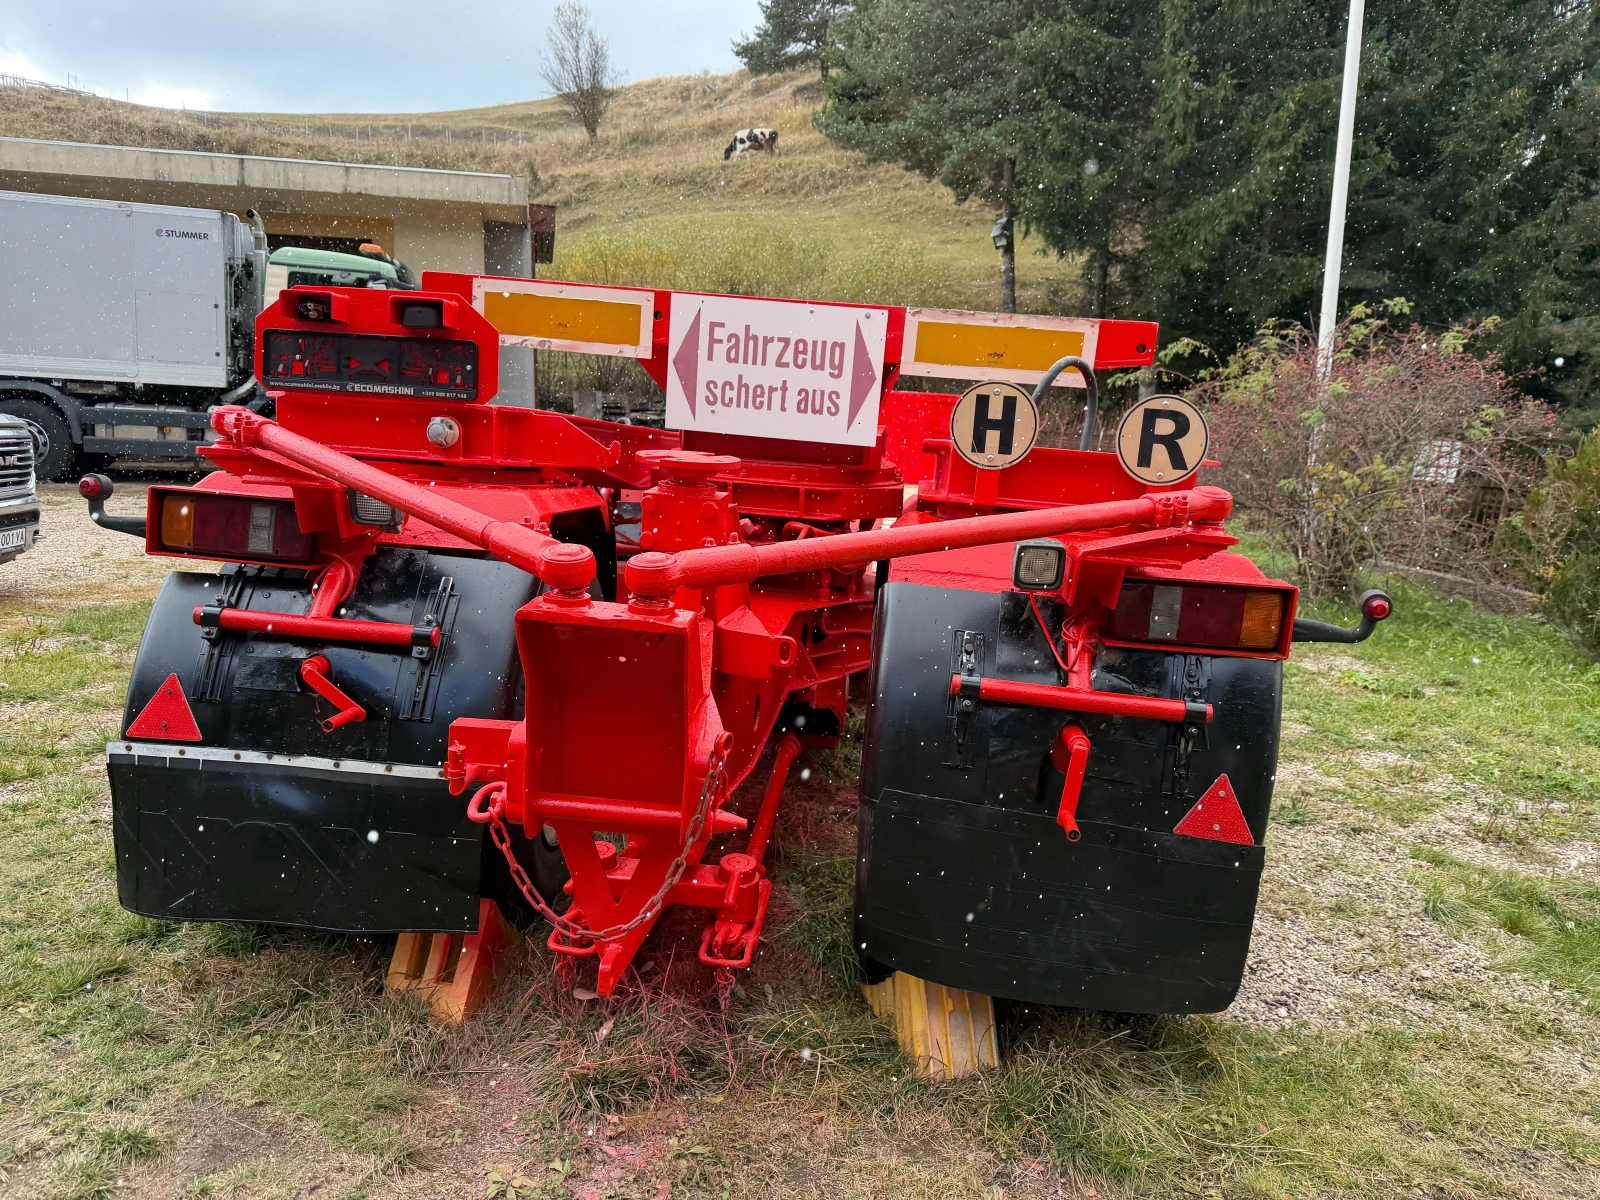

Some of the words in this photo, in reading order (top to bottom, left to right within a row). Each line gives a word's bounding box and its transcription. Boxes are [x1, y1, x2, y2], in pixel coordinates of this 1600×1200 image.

[165, 229, 209, 240] STUMMER
[706, 321, 846, 379] Fahrzeug
[354, 383, 414, 396] ECOMASHINI
[704, 374, 789, 413] schert
[796, 387, 841, 417] aus
[971, 393, 1018, 455] H
[1136, 407, 1189, 471] R
